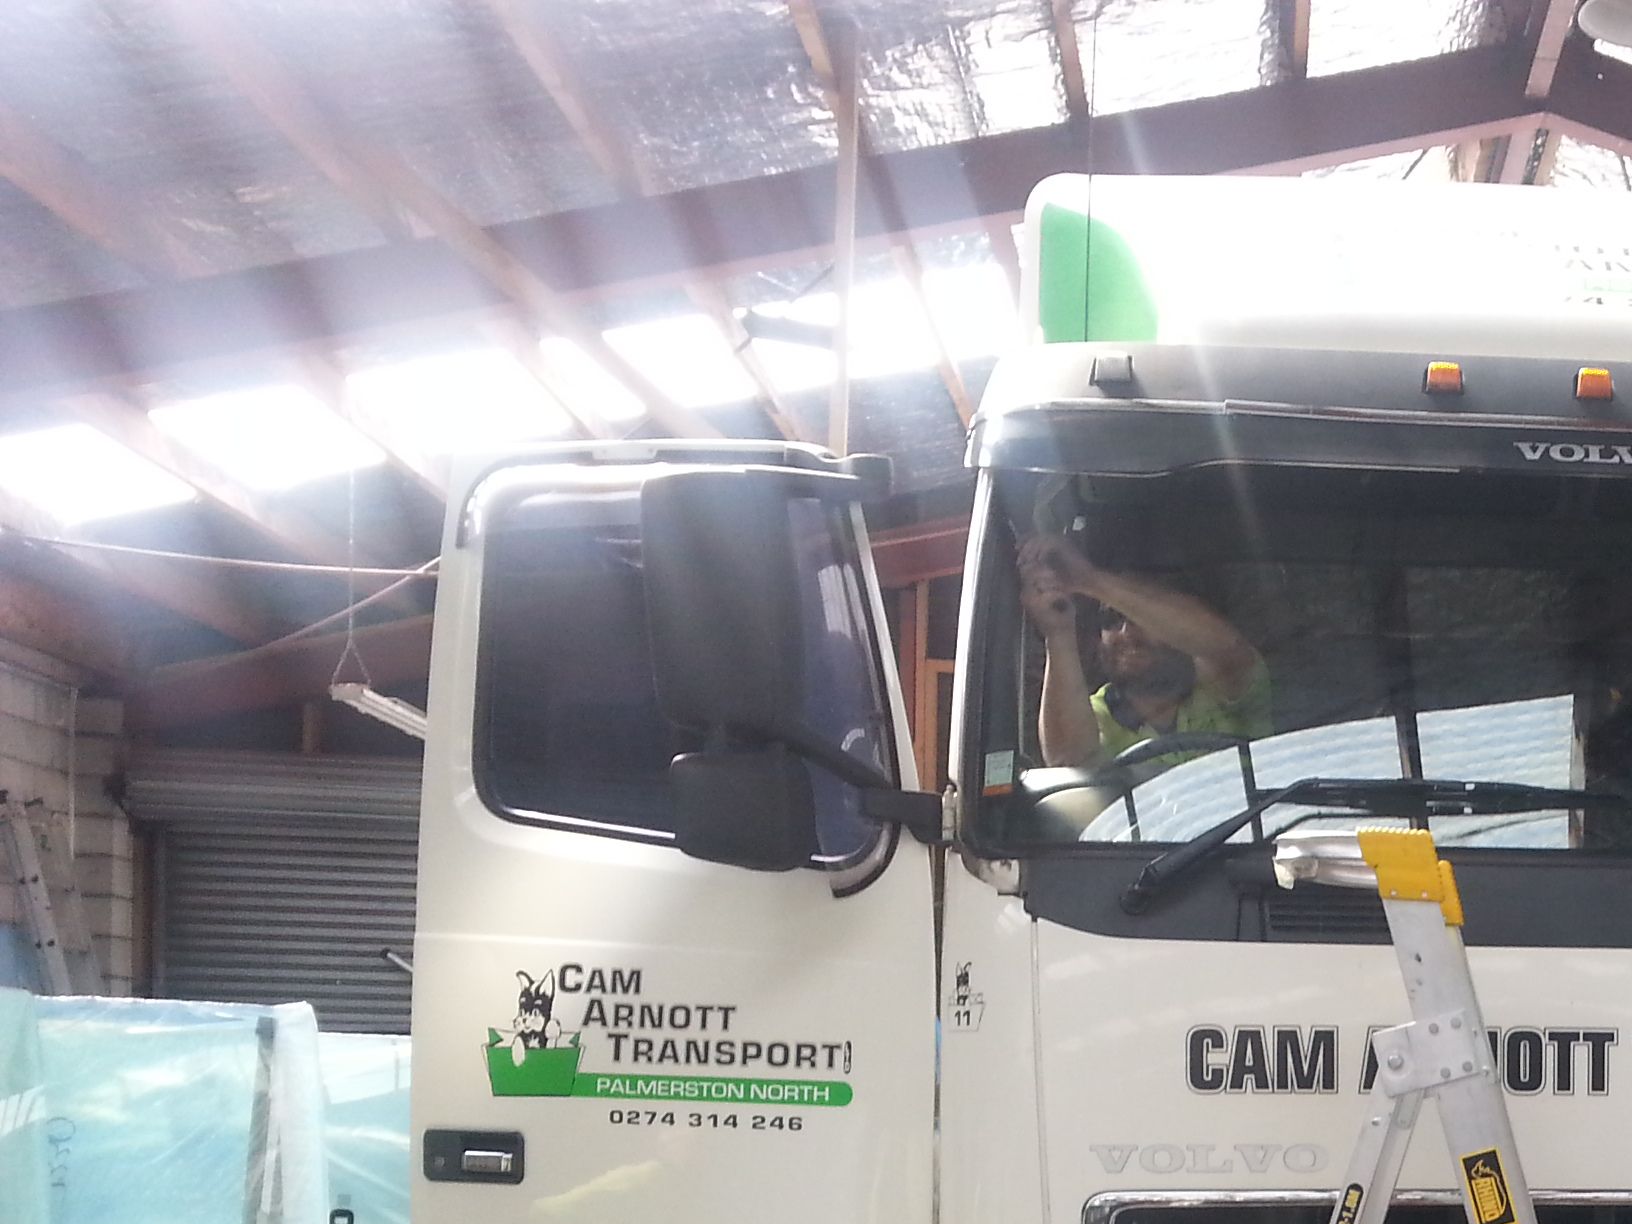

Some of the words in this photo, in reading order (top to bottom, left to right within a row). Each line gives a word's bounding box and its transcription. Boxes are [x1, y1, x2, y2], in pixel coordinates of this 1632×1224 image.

[558, 963, 643, 995] CAM
[582, 998, 737, 1032] ARNOTT
[953, 1008, 972, 1027] 11
[606, 1032, 844, 1069] TRANSPORT
[1185, 1024, 1339, 1097] CAM
[595, 1077, 745, 1100] PALMERSTON
[750, 1081, 831, 1103] NORTH
[608, 1109, 676, 1126] 0274
[688, 1113, 738, 1128] 314
[751, 1115, 804, 1131] 246
[1089, 1142, 1330, 1174] VOLVO
